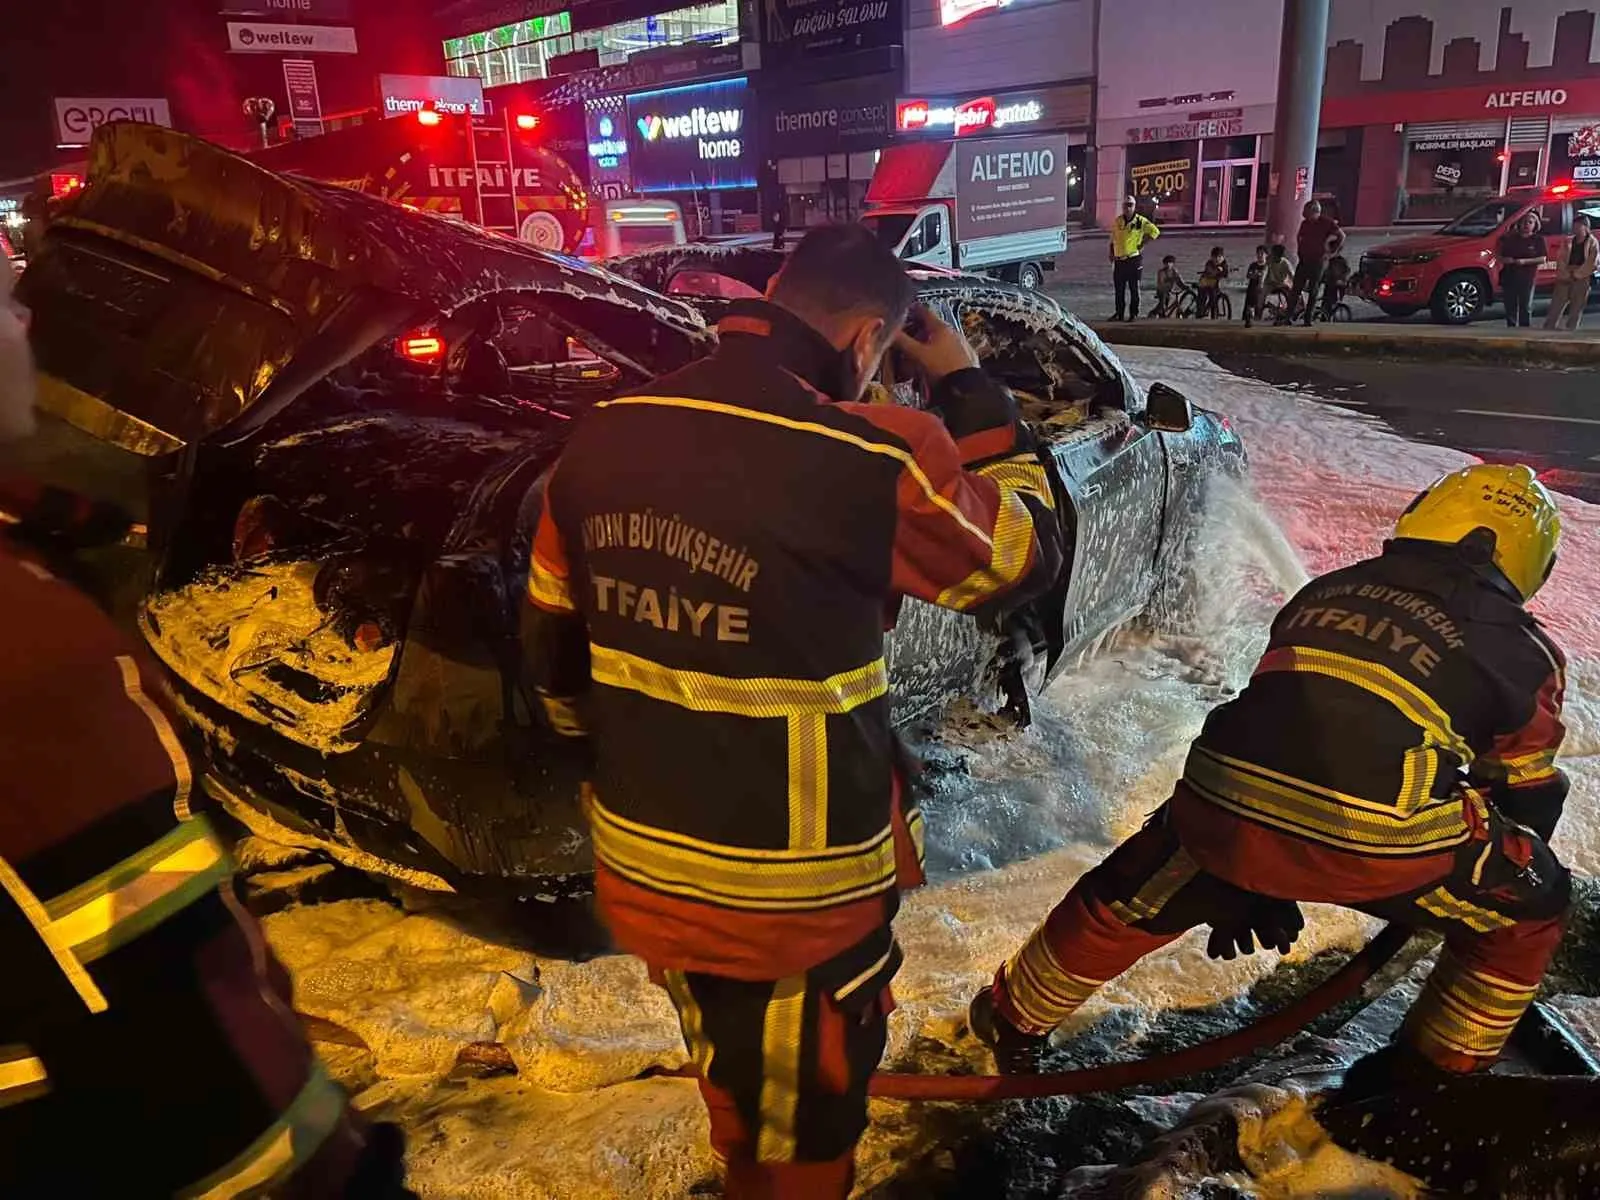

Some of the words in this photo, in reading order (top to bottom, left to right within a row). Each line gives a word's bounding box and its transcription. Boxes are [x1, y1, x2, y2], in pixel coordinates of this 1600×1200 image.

[256, 32, 314, 45] weltew
[1485, 89, 1567, 108] ALFEMO
[662, 107, 740, 138] weltew
[776, 108, 838, 132] themore
[699, 138, 741, 159] home
[971, 149, 1054, 182] ALFEMO
[628, 507, 760, 593] BÜYÜKŞEHİR
[588, 575, 750, 644] TFAİYE
[1287, 606, 1441, 679] İTFAİYE
